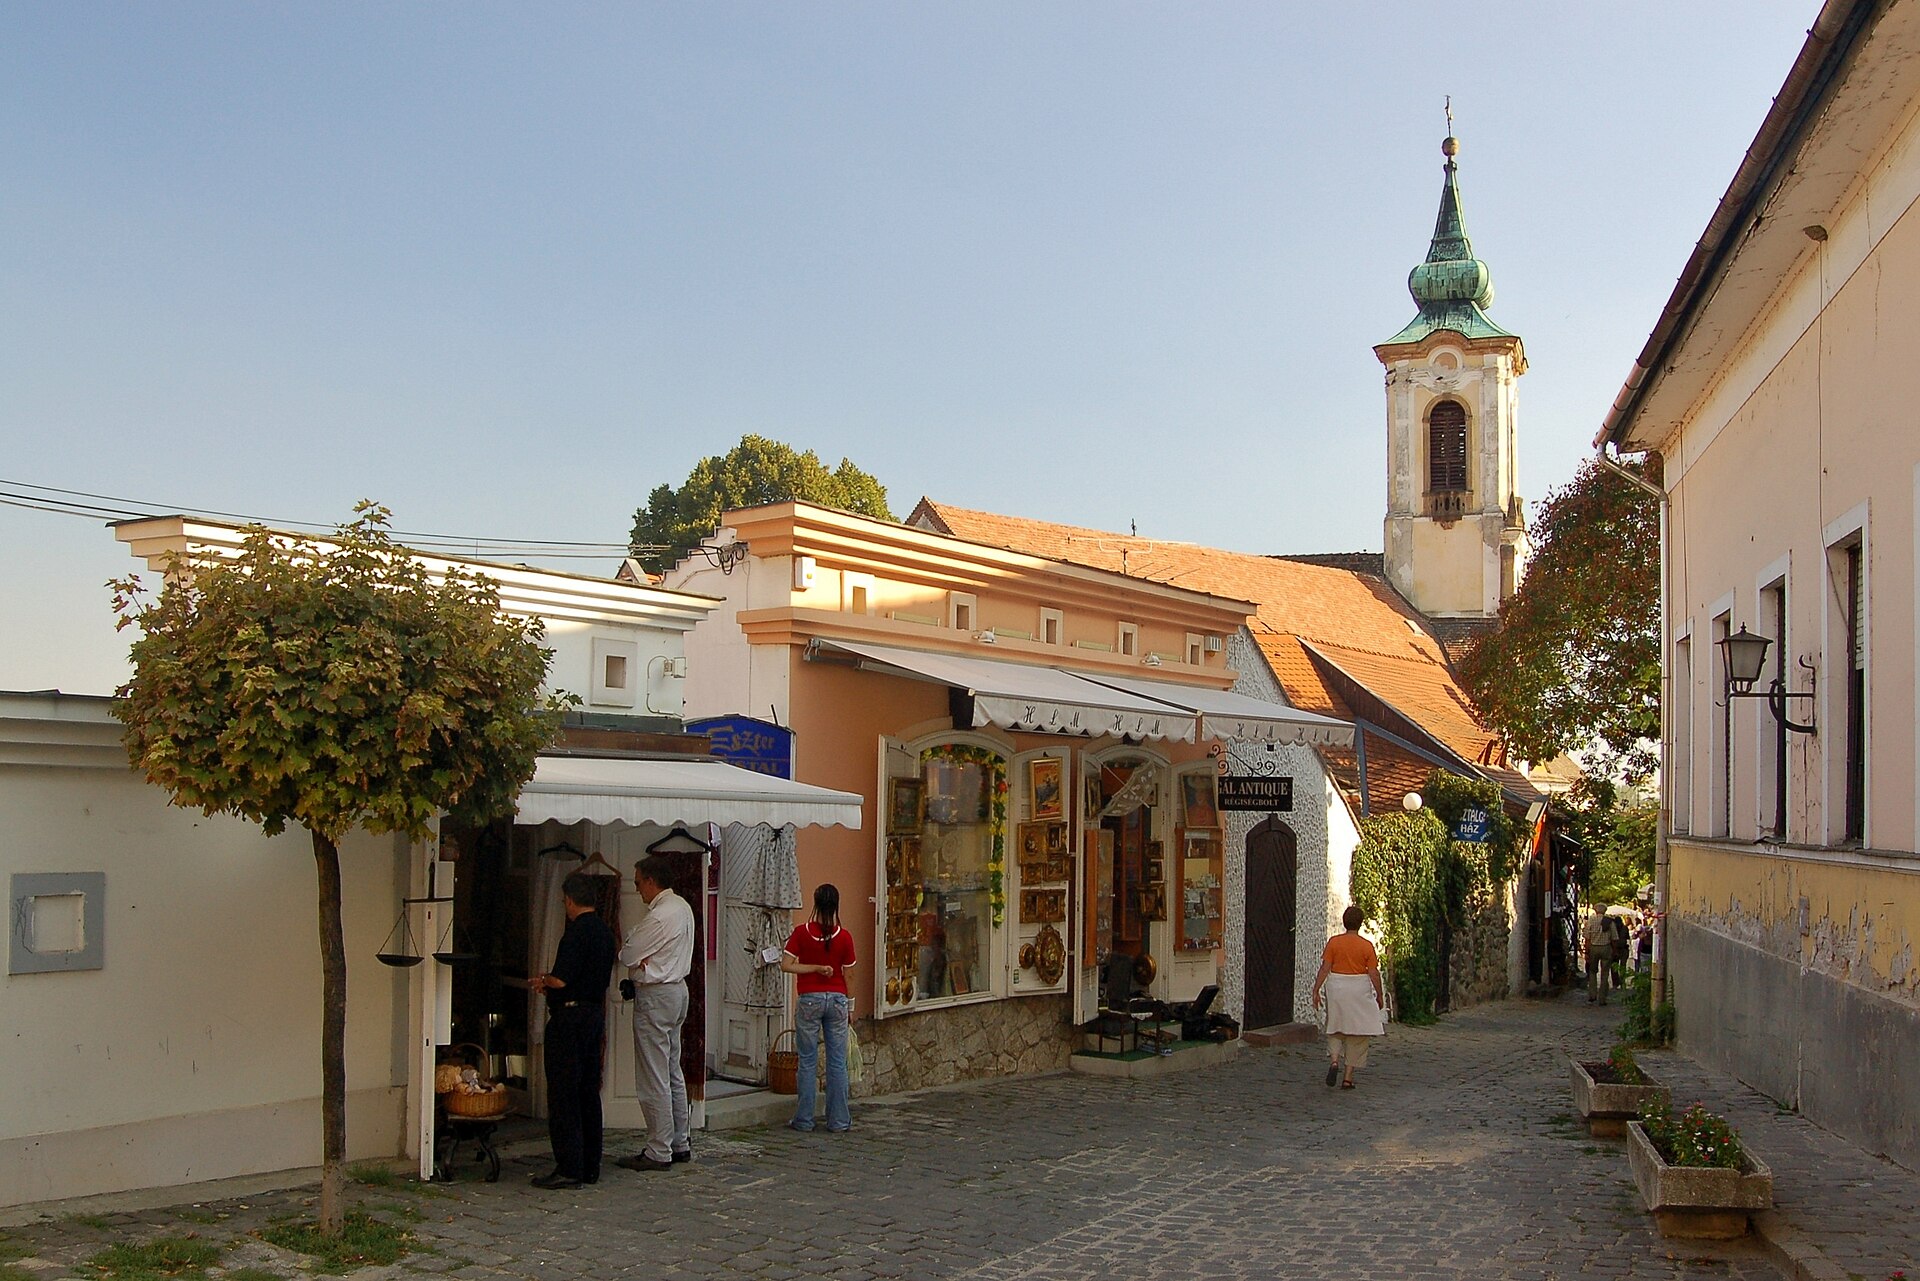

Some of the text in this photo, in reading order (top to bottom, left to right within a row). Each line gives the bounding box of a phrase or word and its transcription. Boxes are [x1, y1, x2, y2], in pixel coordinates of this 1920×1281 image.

[1238, 781, 1288, 797] ANTIQUE
[1224, 796, 1280, 807] RÉGISÉGBOLT
[1460, 822, 1480, 834] HÁZ
